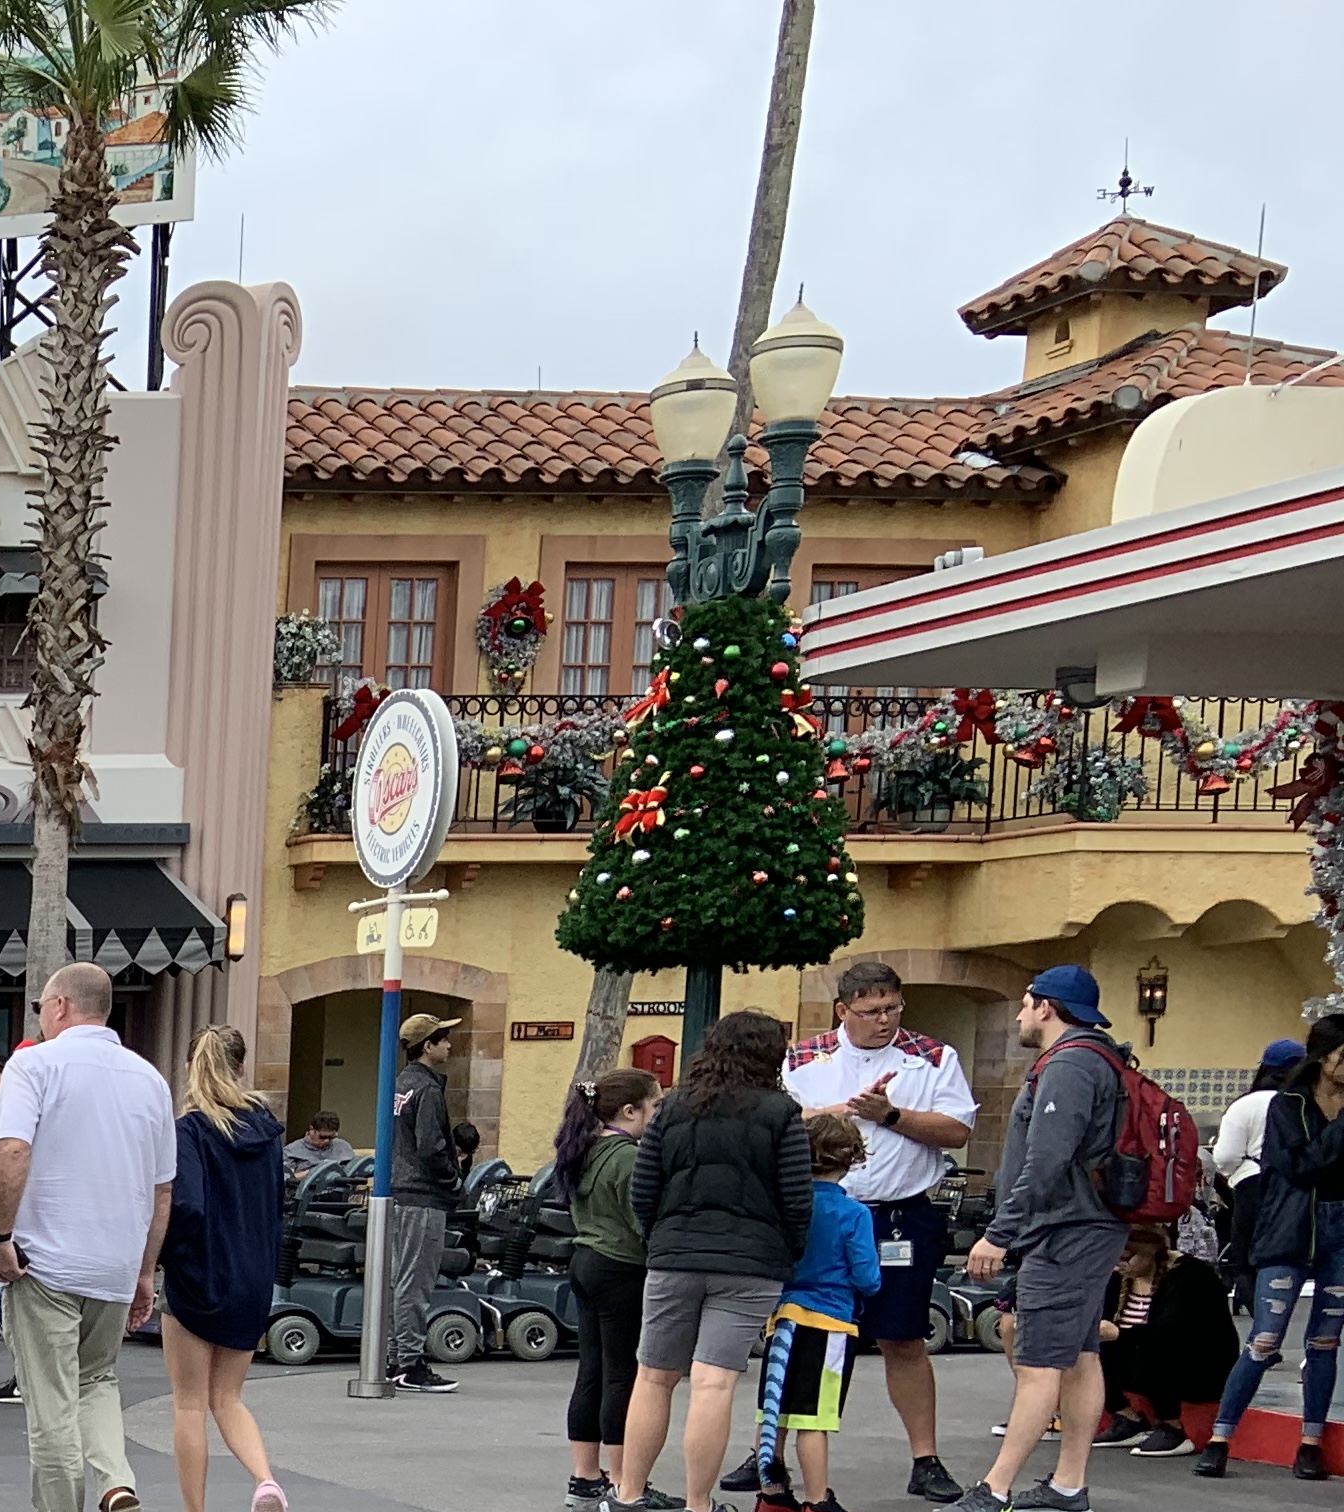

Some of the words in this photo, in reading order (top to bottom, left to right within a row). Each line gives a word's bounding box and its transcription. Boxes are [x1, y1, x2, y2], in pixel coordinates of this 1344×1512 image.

[364, 720, 393, 786] STROLLERS
[396, 713, 430, 774] WHEELCHAIRS
[368, 758, 420, 828] Oscar's
